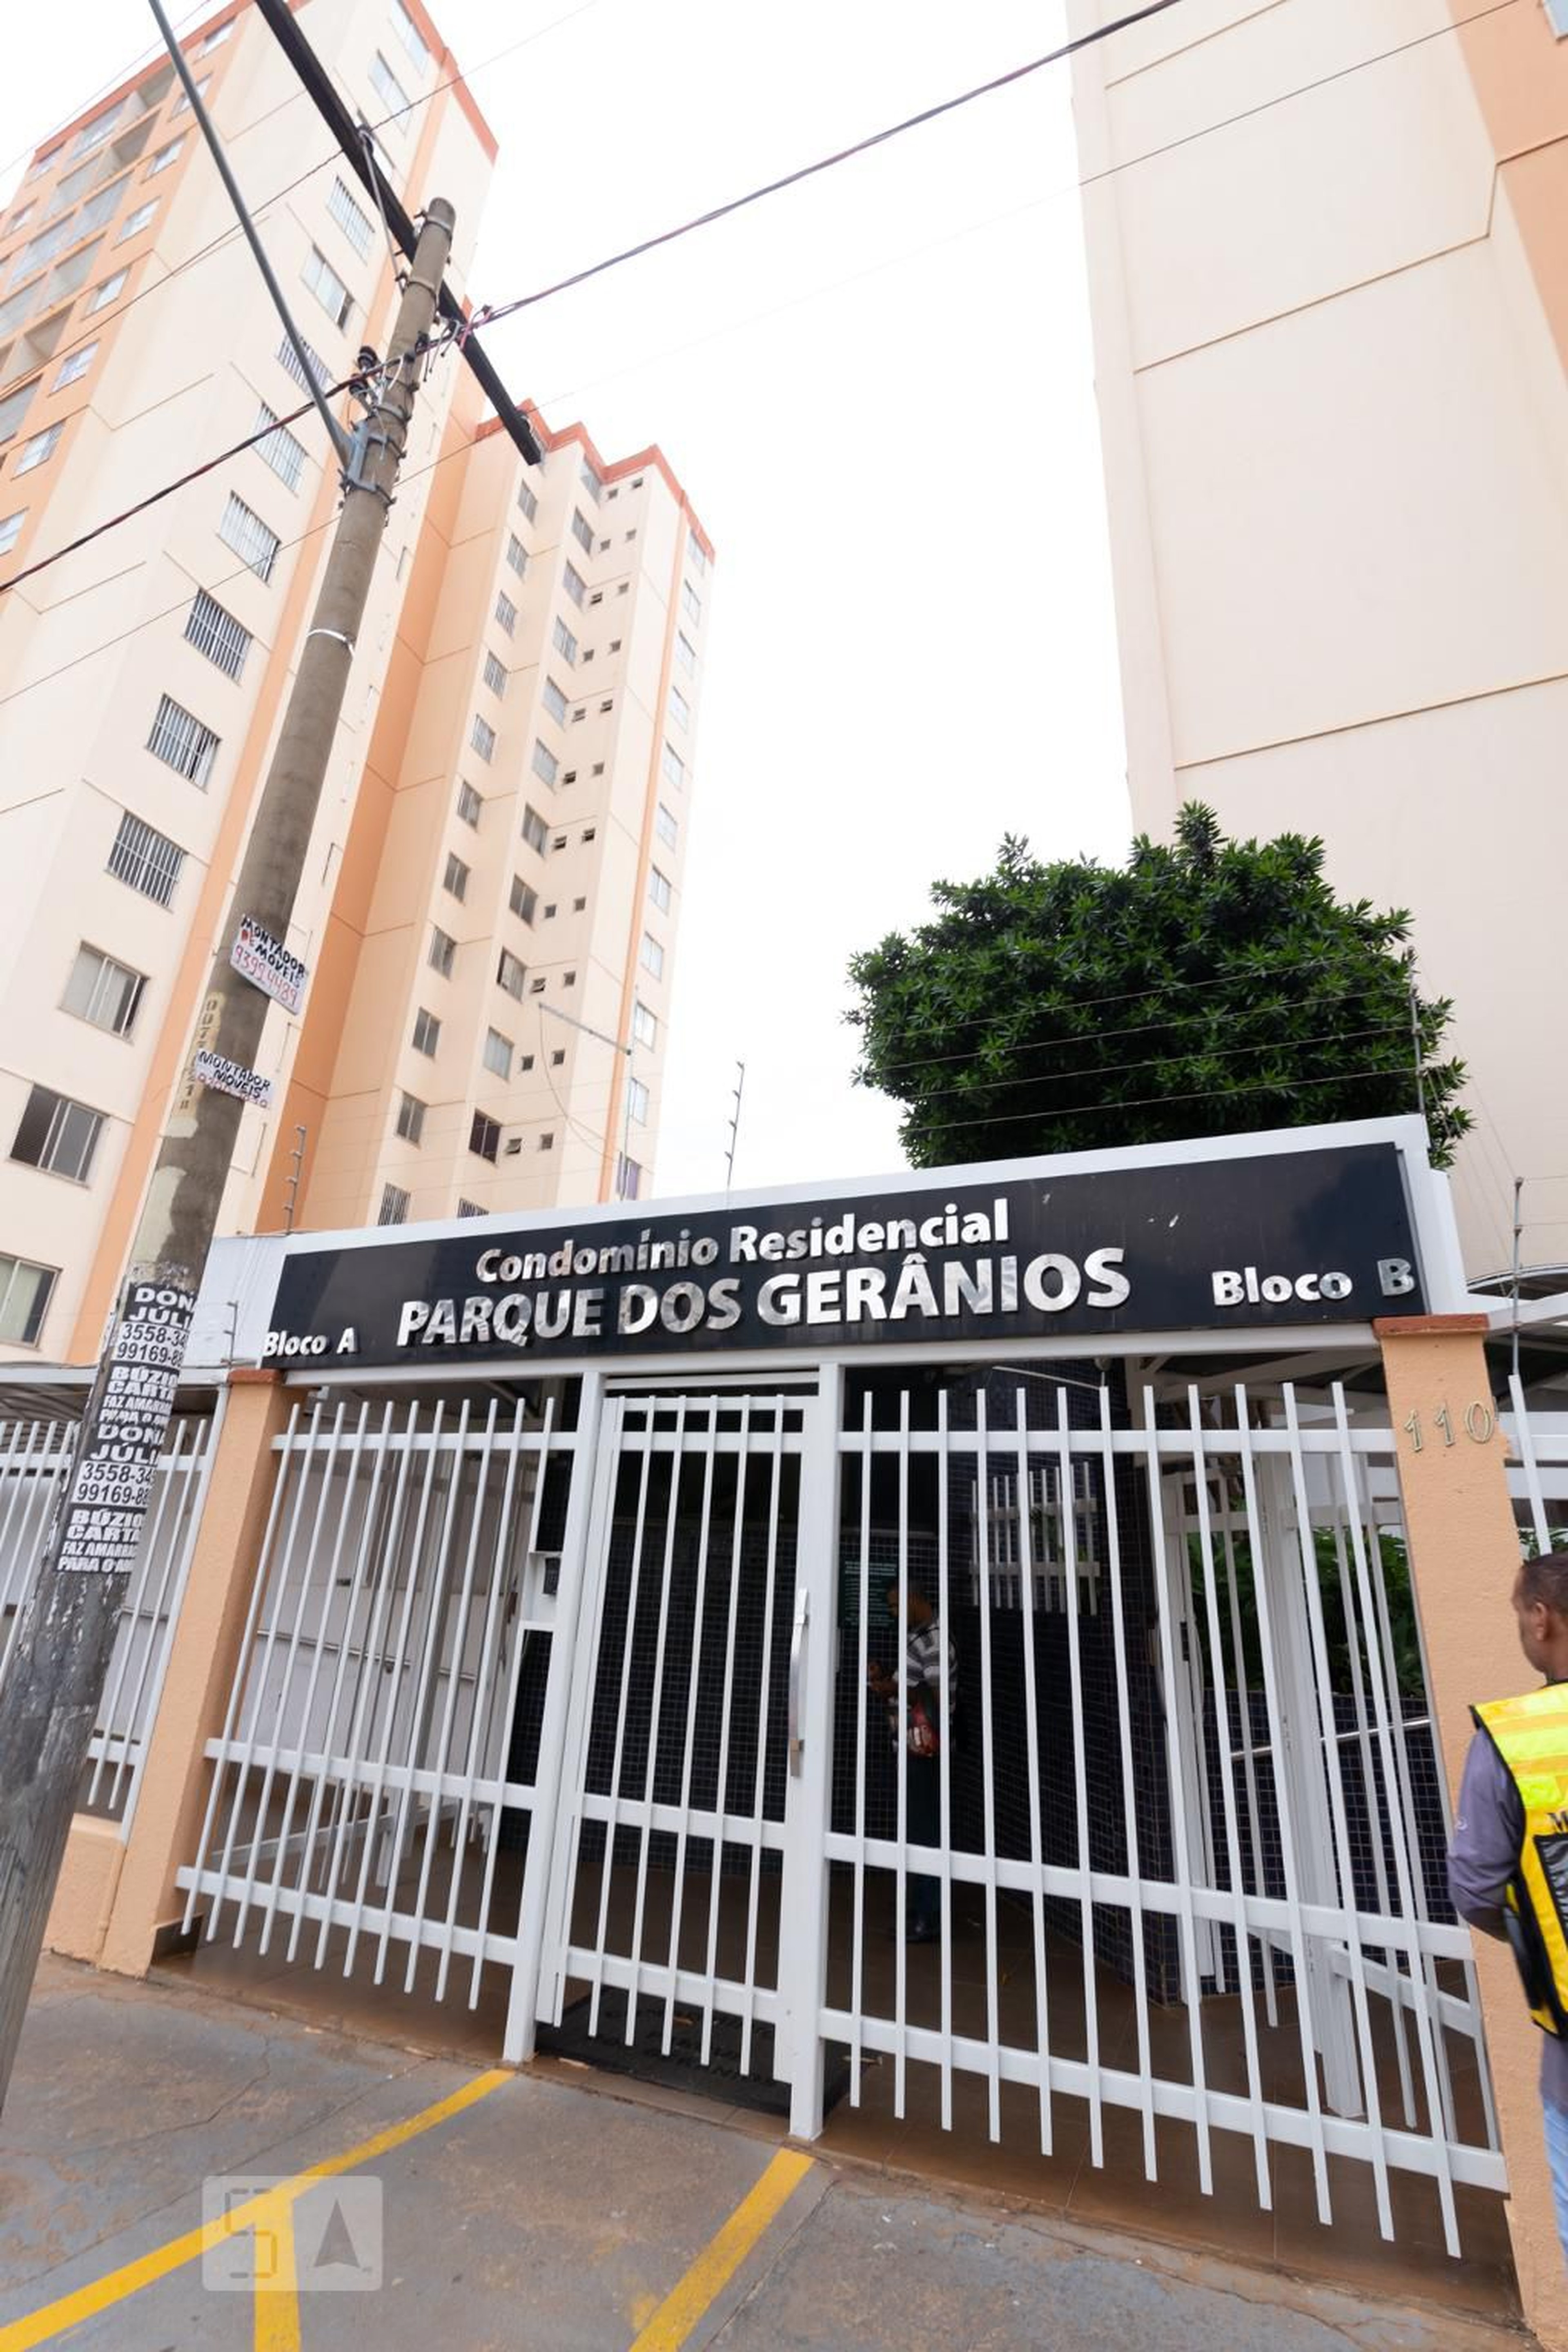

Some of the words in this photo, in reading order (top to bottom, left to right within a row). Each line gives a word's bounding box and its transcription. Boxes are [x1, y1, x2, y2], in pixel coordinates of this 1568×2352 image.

[241, 917, 305, 978] MONTADOR
[199, 1051, 270, 1091] MONTADOR
[476, 1228, 719, 1283] Condomínio
[730, 1198, 1009, 1262] Residencial
[396, 1288, 604, 1347] PARQUE
[617, 1278, 741, 1336] DOS
[757, 1247, 1131, 1326] GERÂNIOS
[1212, 1266, 1353, 1306] Bloco
[1377, 1258, 1415, 1296] B
[263, 1331, 329, 1357] Bloco
[336, 1327, 357, 1355] A
[1404, 1400, 1495, 1452] 110
[57, 1556, 100, 1572] PARA
[61, 1541, 86, 1555] FAZ
